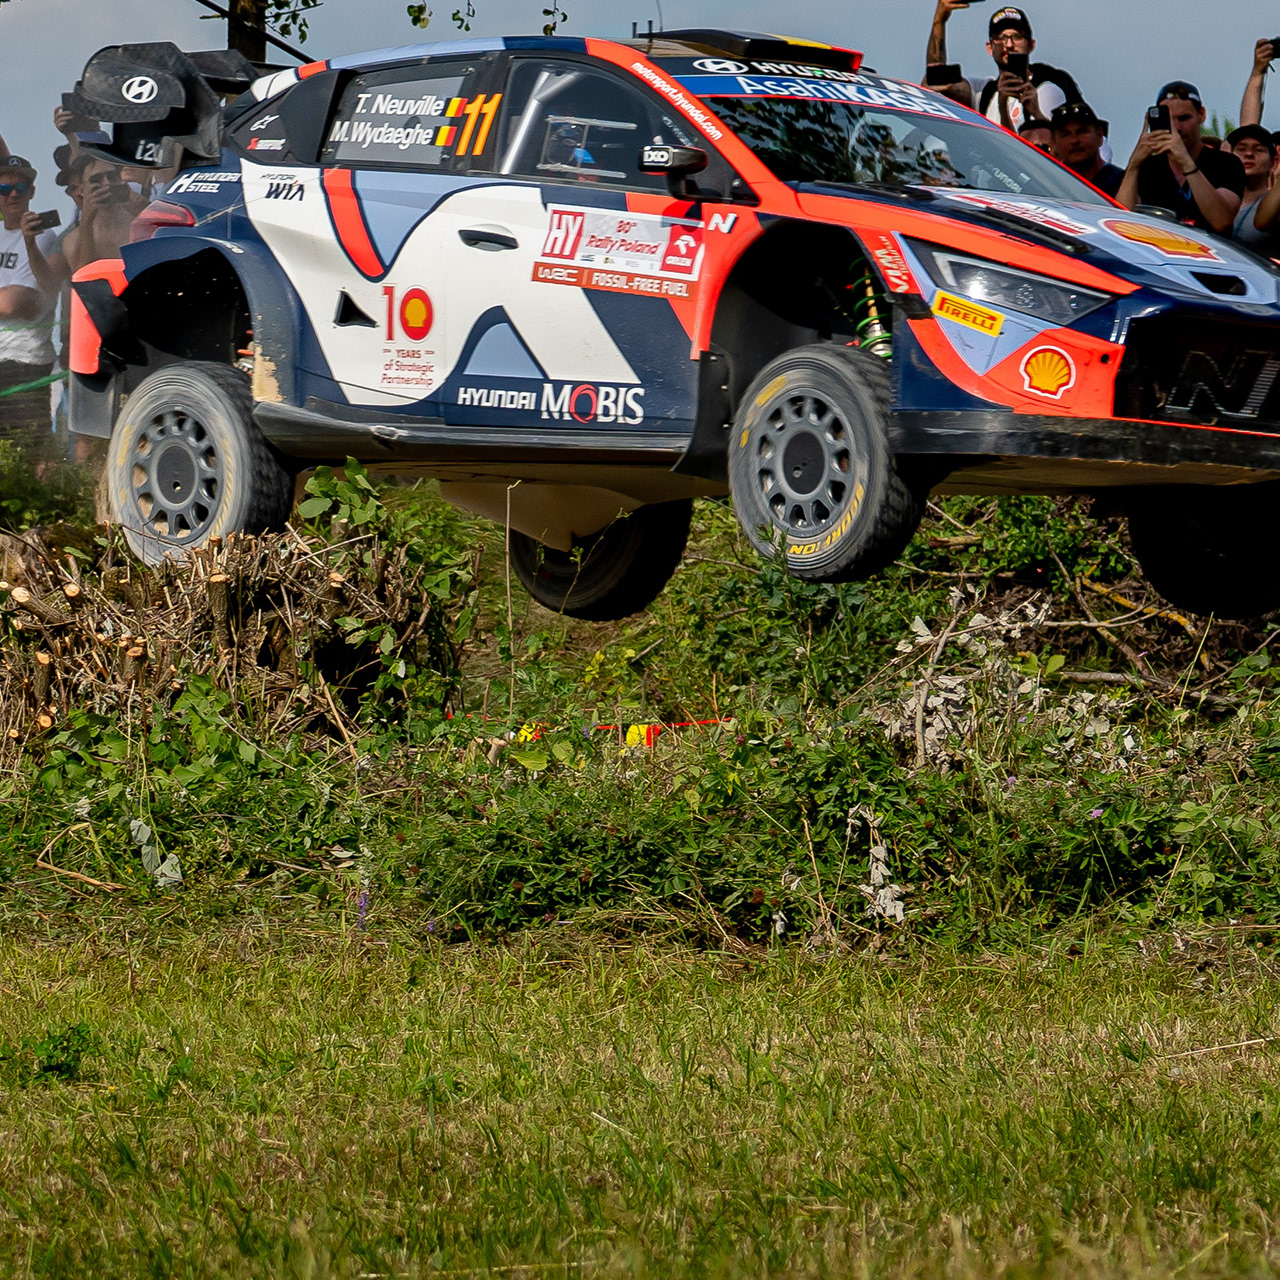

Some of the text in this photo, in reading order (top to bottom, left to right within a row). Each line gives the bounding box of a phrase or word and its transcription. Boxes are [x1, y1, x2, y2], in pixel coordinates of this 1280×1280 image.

[355, 94, 446, 116] T. Neuville
[631, 62, 723, 140] motorsport.hyundai.com
[455, 93, 503, 156] 11
[186, 183, 221, 194] STEEL
[585, 234, 664, 256] Rally Poland
[591, 272, 690, 298] FOSSIL-FREE FUEL
[938, 297, 998, 330] PIRELLI
[396, 349, 422, 359] YEARS
[383, 359, 434, 375] of Strategic
[381, 373, 434, 387] Partnership
[457, 383, 646, 425] HYUNDAI MOBIS
